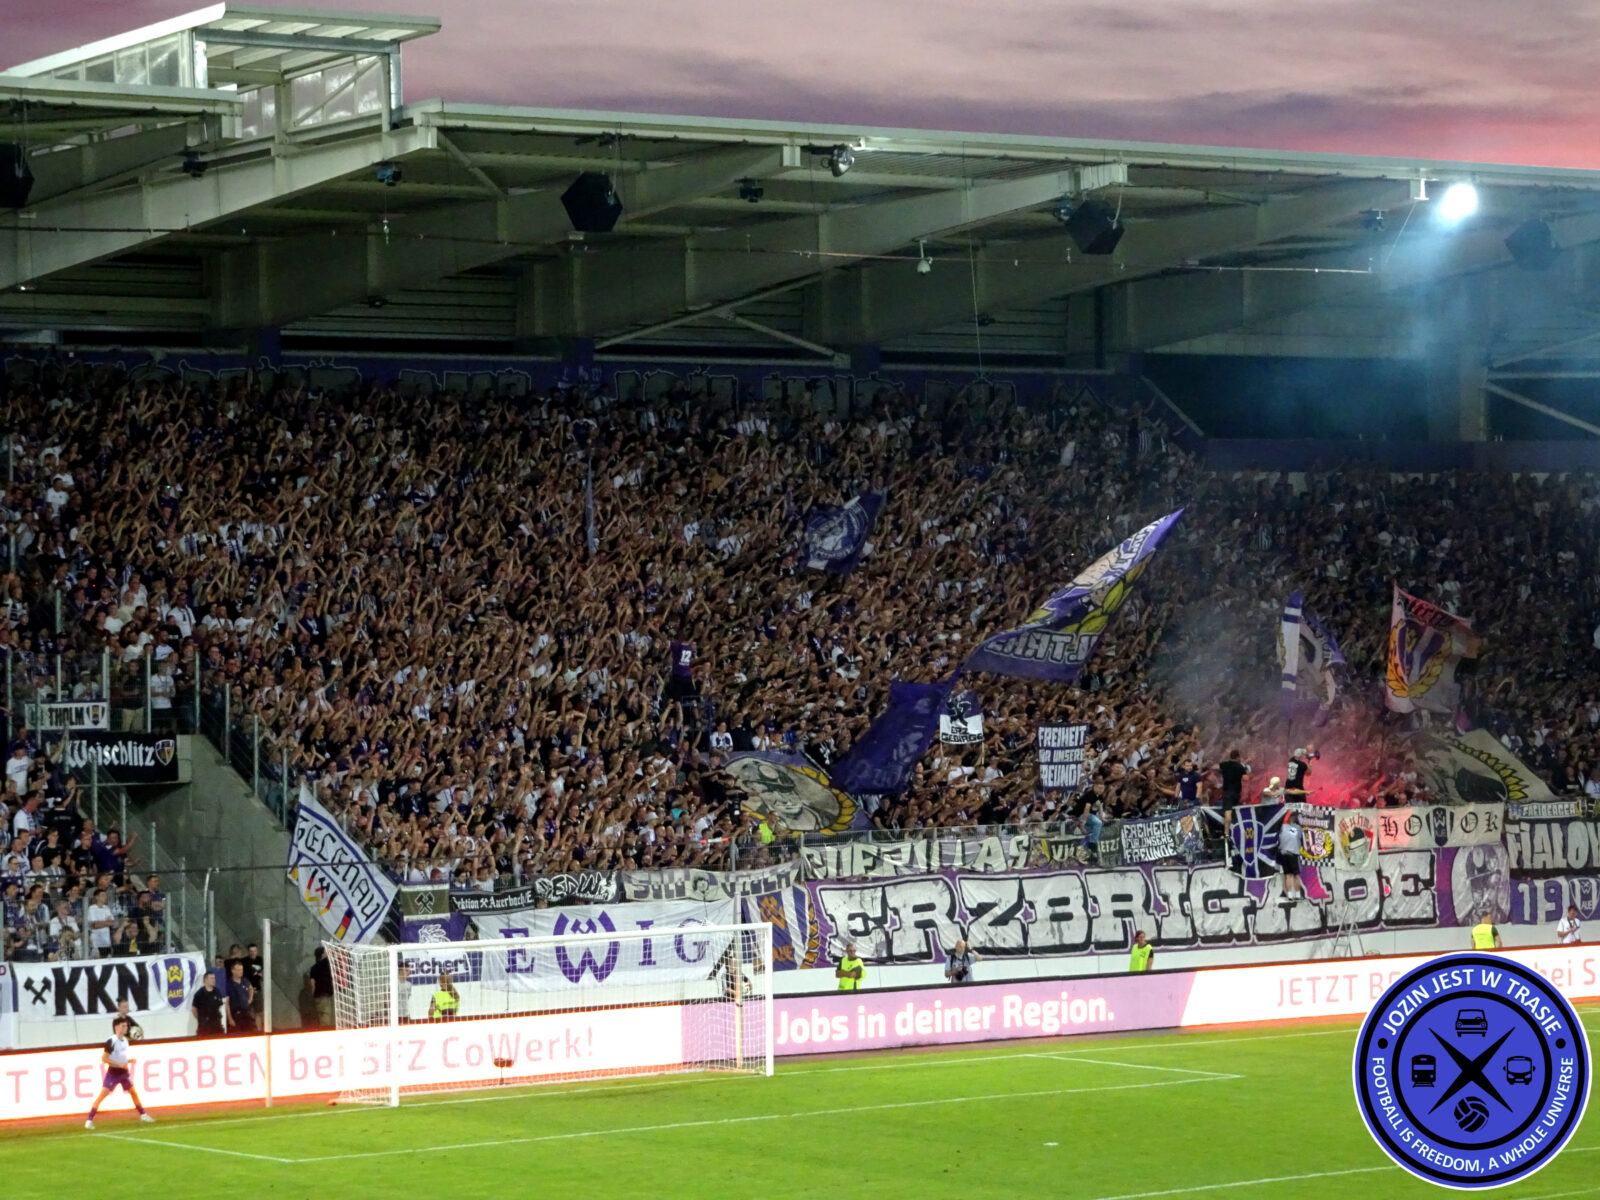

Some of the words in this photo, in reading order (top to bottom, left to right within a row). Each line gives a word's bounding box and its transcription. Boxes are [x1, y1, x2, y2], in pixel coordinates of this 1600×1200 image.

[1038, 725, 1087, 747] FREIHEIT
[1123, 819, 1171, 838] FREIHEIT
[1125, 842, 1177, 864] FREUNDE
[818, 848, 1438, 964] ERZBRIGADE
[500, 910, 710, 983] EWIG
[52, 962, 150, 1016] KKN
[168, 989, 183, 998] AUE
[1277, 972, 1363, 1007] JETZT
[777, 1008, 849, 1045] Jobs
[857, 1006, 886, 1038] in
[894, 999, 996, 1036] deiner
[1003, 992, 1115, 1033] Region.
[289, 1044, 345, 1081] bei
[442, 1026, 594, 1068] CoWerk!
